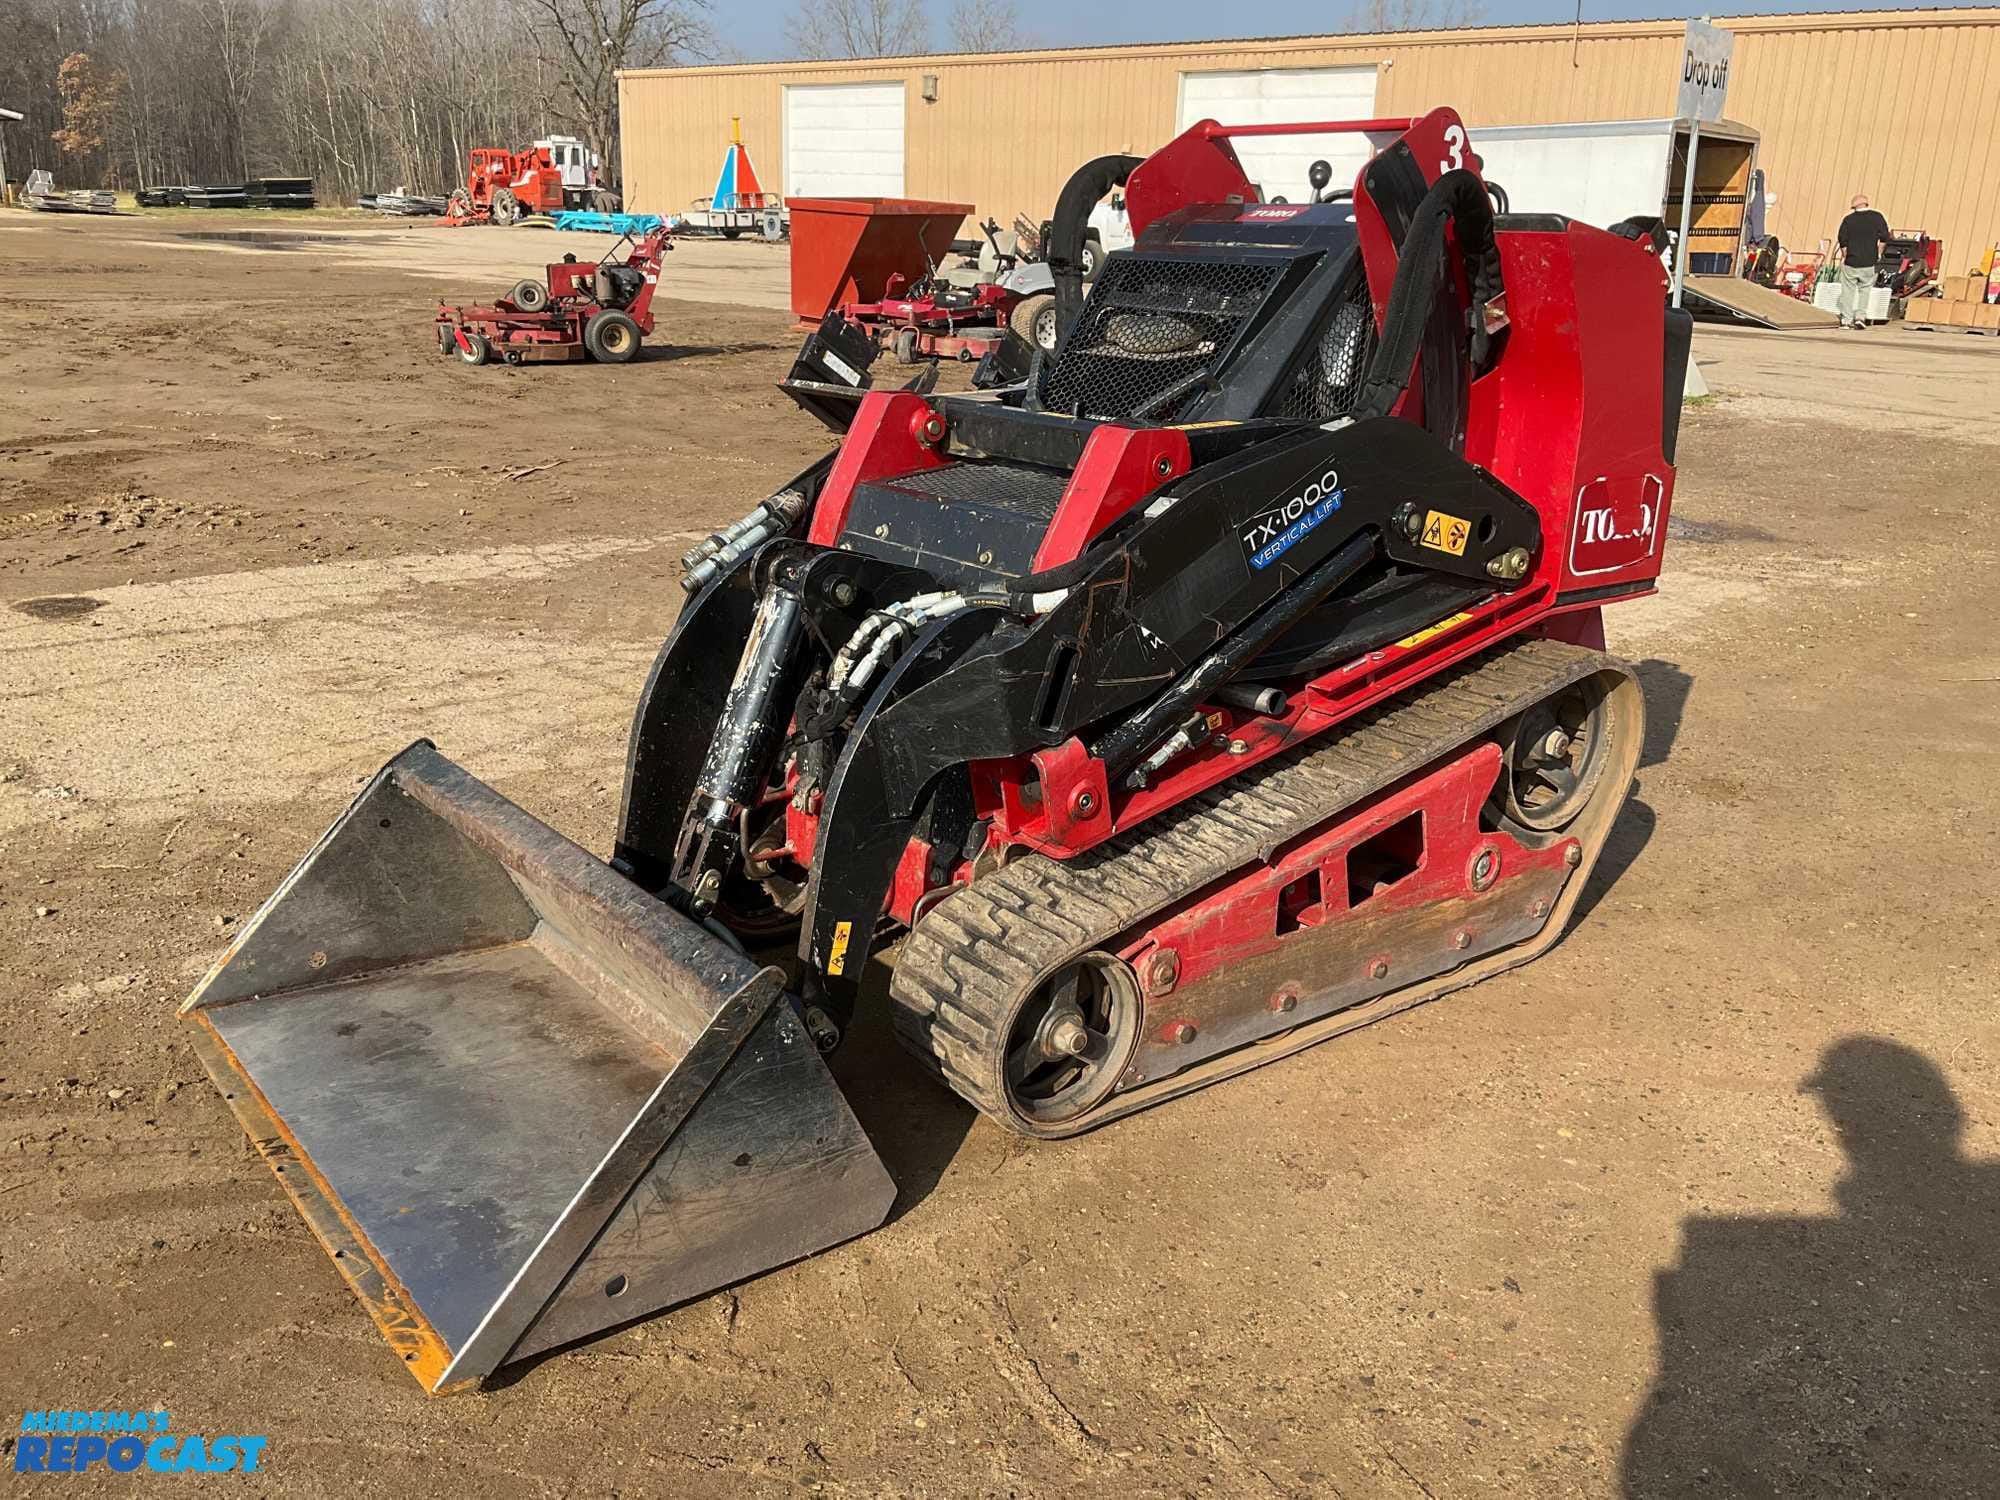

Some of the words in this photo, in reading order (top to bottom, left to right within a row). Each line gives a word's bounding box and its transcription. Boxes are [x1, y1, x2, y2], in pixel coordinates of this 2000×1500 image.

[1684, 49, 1709, 96] Drop
[1712, 57, 1729, 91] off
[1440, 124, 1465, 176] 3
[1254, 516, 1315, 565] VERTICAL
[1316, 493, 1341, 519] LIFT
